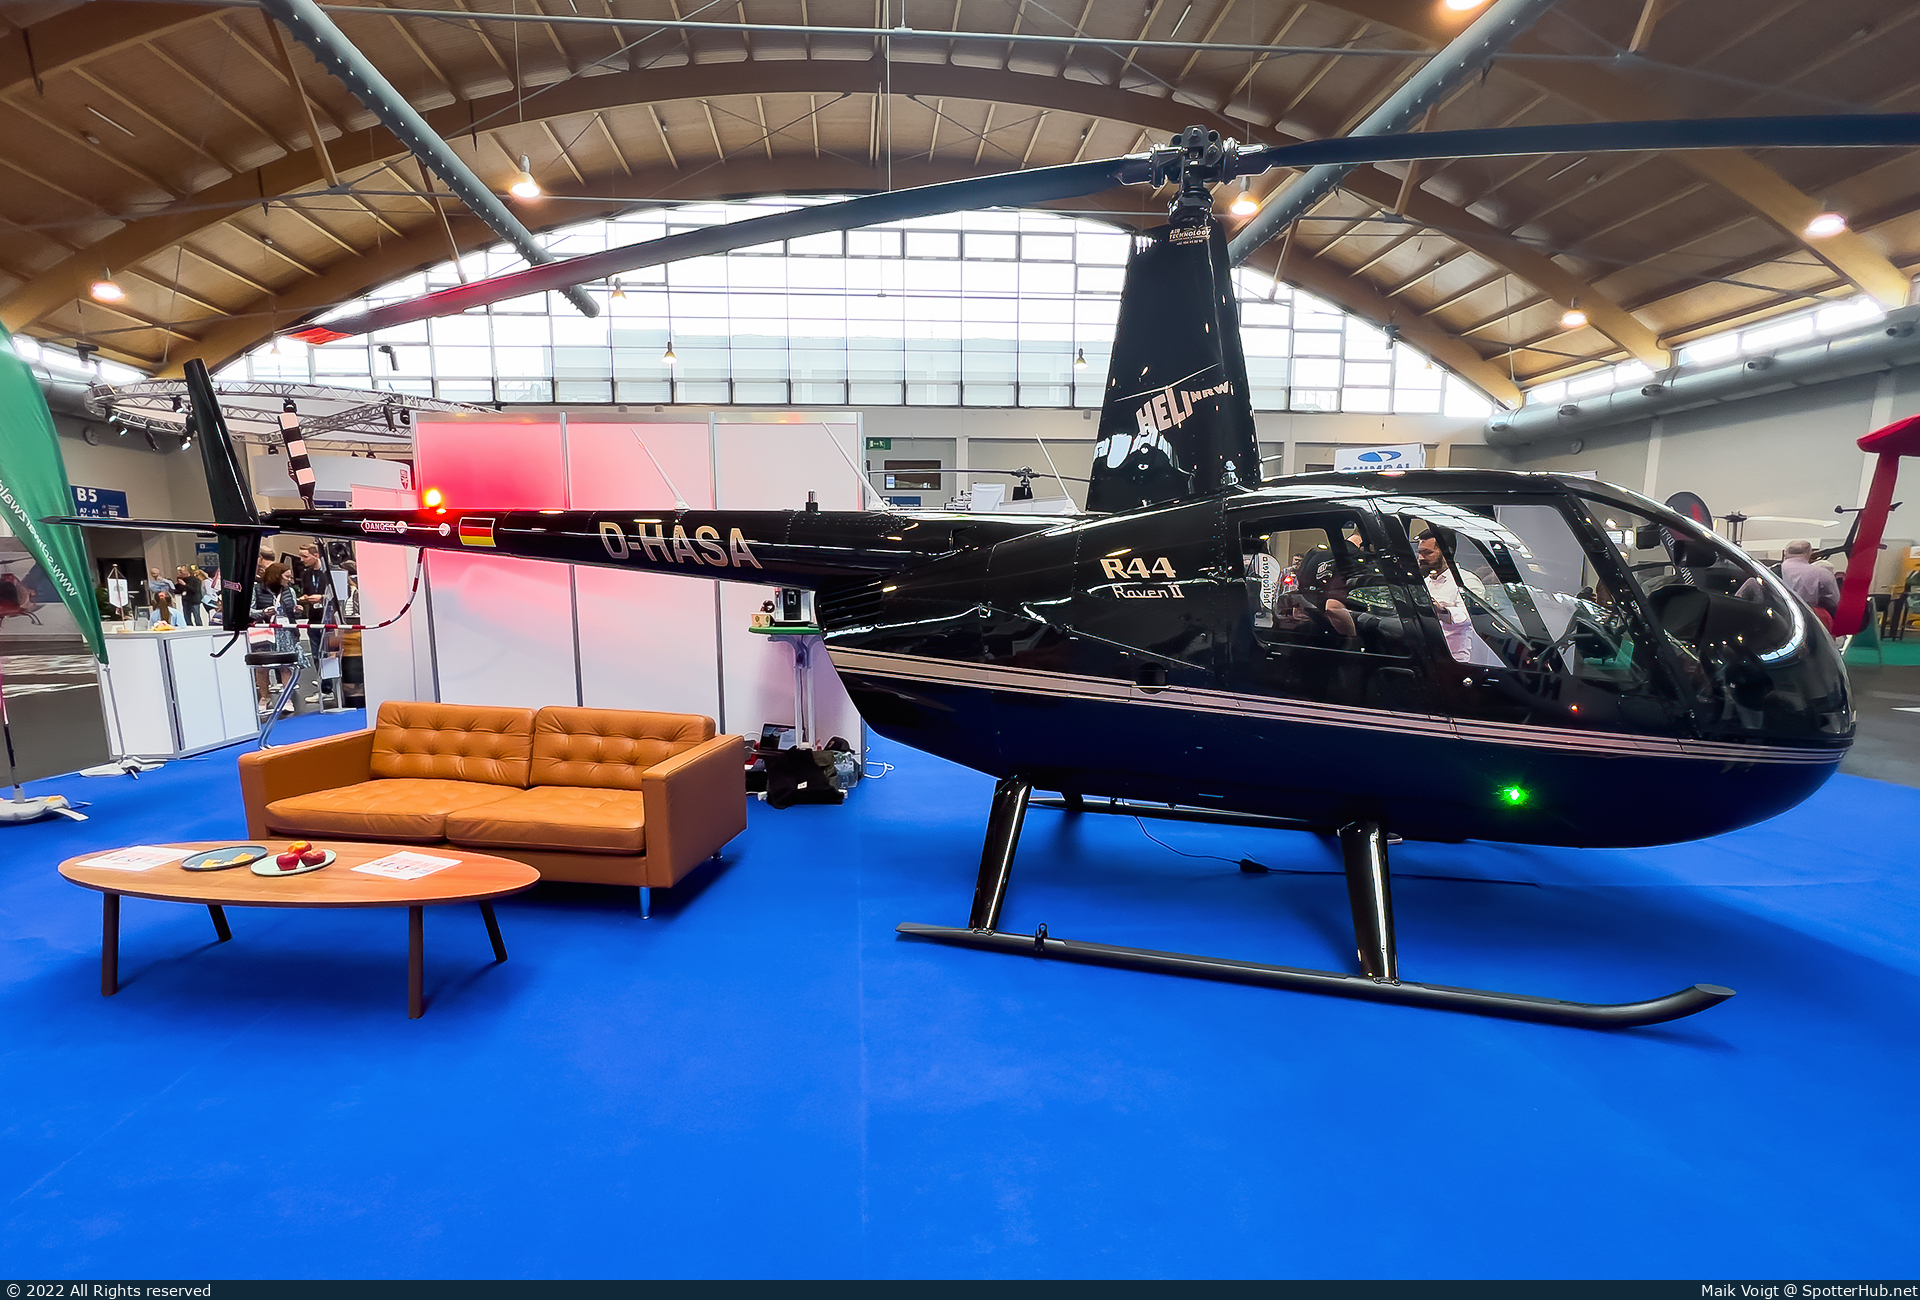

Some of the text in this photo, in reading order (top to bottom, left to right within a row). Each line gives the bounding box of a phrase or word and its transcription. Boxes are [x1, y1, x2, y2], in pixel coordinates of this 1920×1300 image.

[1169, 228, 1211, 239] TECHNOLOGY
[364, 521, 396, 532] DANGER
[599, 521, 764, 570] D-HASA
[1100, 557, 1177, 579] R44
[1111, 584, 1169, 599] Raven
